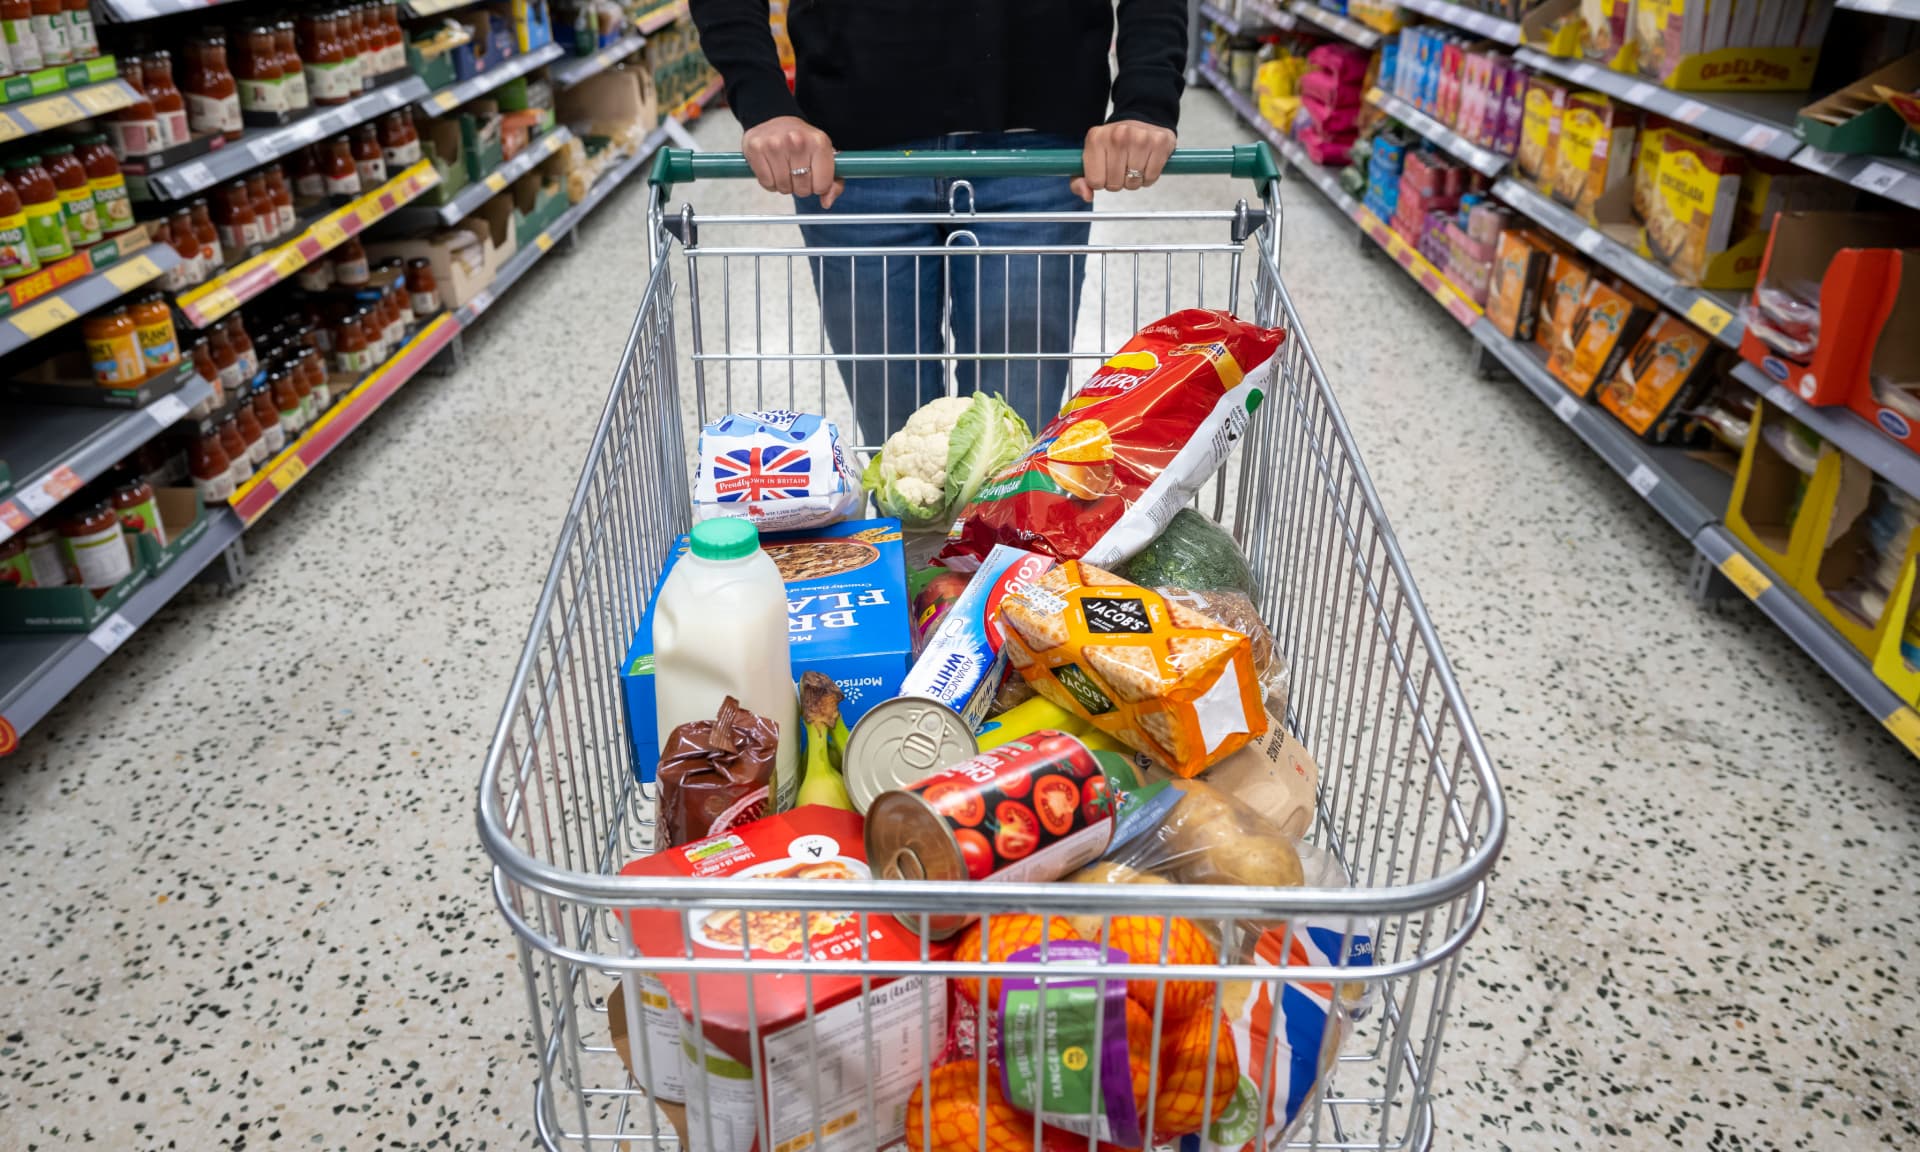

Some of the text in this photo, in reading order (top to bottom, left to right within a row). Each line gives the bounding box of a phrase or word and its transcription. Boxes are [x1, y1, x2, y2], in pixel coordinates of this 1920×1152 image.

[719, 479, 751, 492] Proudly
[767, 478, 776, 486] IN
[777, 477, 807, 486] BRITAIN
[787, 588, 890, 614] FLA
[788, 609, 860, 633] BR
[1087, 601, 1144, 631] JACOB'S
[834, 676, 883, 688] Morriso
[941, 656, 974, 701] ADVANCED
[807, 847, 823, 857] 4
[829, 930, 884, 956] BKED
[1047, 1010, 1064, 1099] TANGERINES
